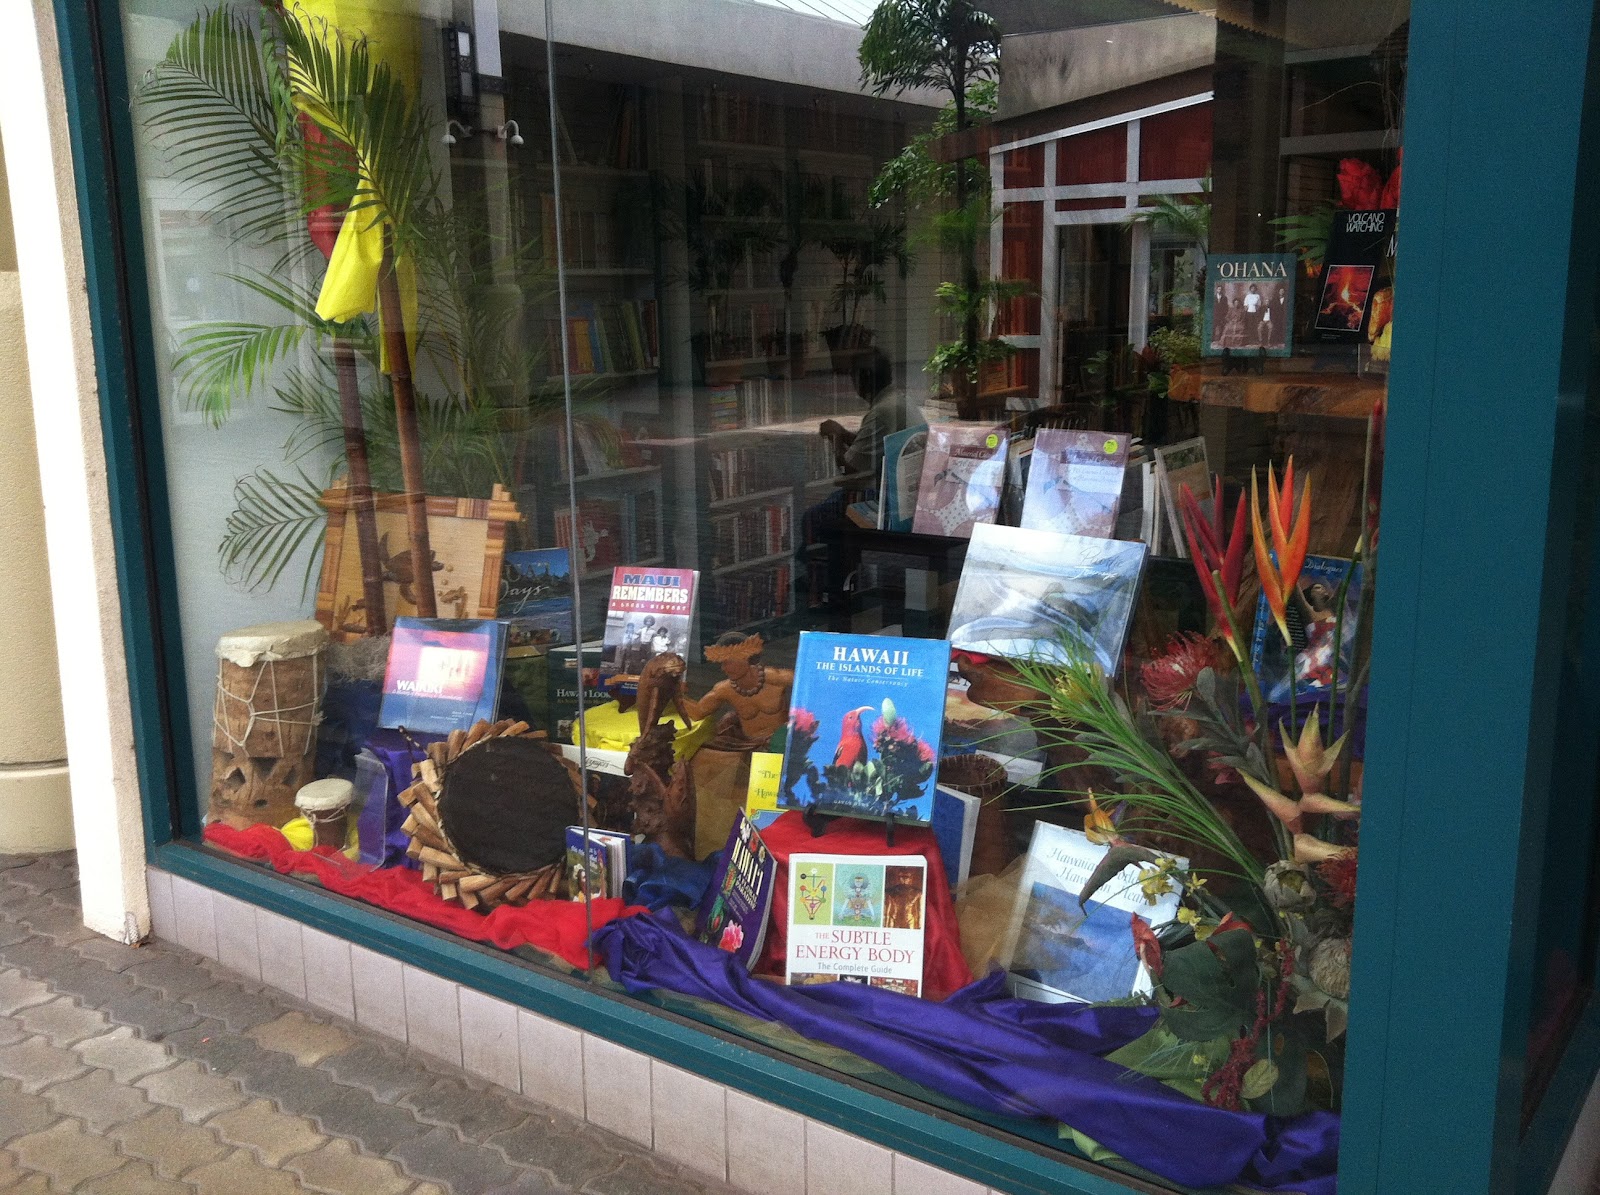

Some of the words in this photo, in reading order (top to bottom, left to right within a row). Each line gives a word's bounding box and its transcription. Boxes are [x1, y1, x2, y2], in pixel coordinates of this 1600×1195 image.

[1348, 212, 1385, 223] VOLCANO
[1346, 221, 1384, 233] WATCHING
[1304, 561, 1343, 575] Dialogues
[623, 574, 681, 587] MAUI
[612, 586, 689, 604] REMEMBERS
[833, 646, 909, 666] HAWAII
[816, 661, 836, 671] THE
[839, 663, 882, 674] ISLANDS
[884, 667, 898, 675] OF
[901, 668, 924, 678] LIFE
[1047, 847, 1097, 872] Hawaiia
[831, 930, 892, 945] SUBTLE
[796, 945, 863, 960] ENERGY
[868, 948, 915, 963] BODY
[818, 962, 831, 970] The
[833, 963, 868, 973] Complete
[871, 965, 892, 974] Guide
